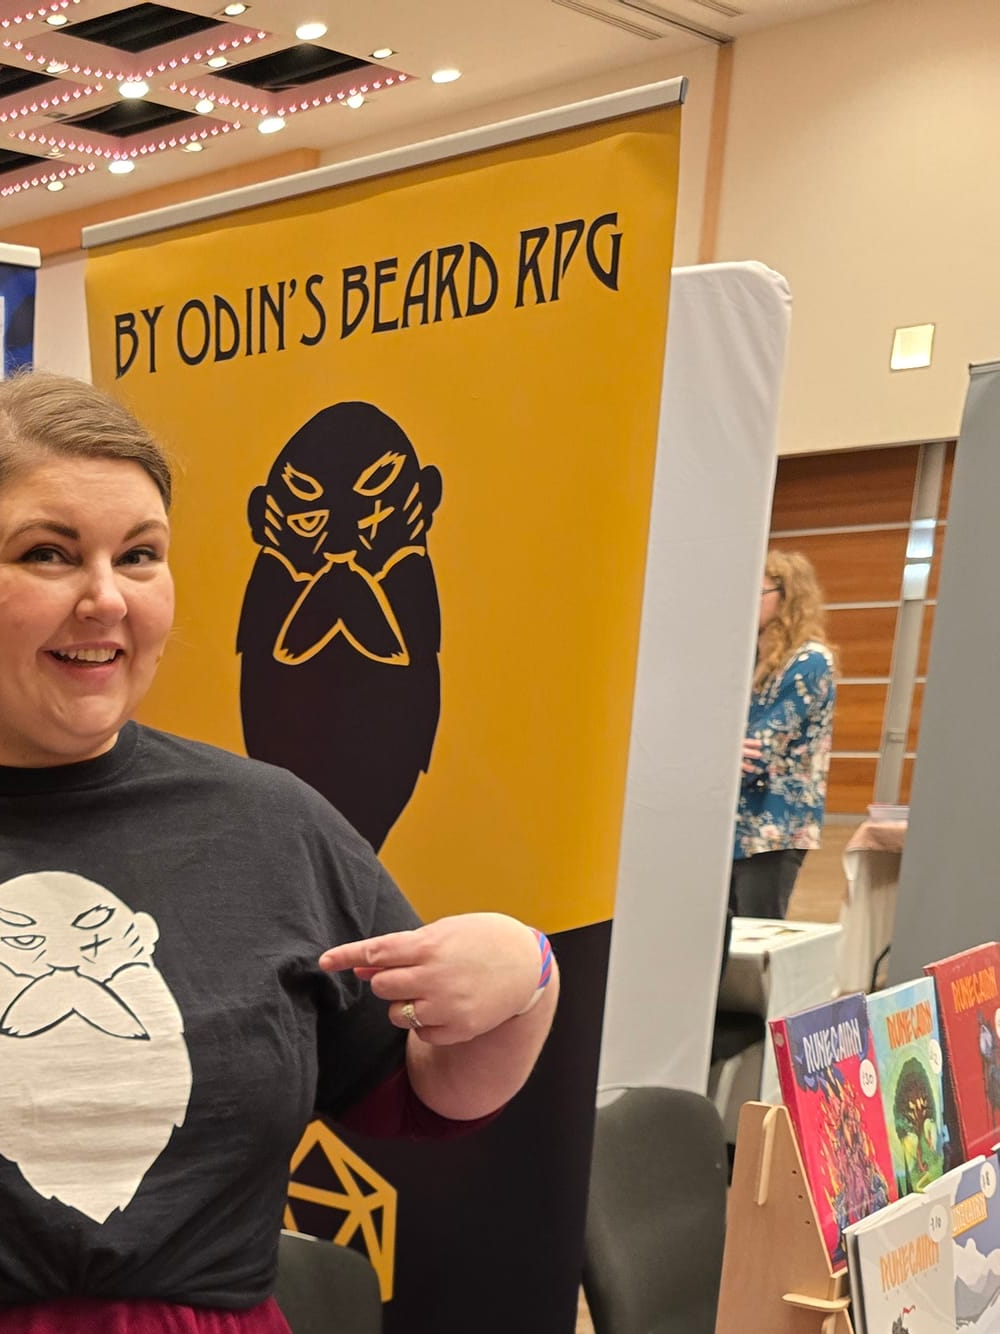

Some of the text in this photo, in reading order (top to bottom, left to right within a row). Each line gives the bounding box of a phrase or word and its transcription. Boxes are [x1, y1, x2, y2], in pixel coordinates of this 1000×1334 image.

[114, 212, 624, 379] BY ODIN'S BEARD RPG
[803, 1019, 862, 1074] RUNECAIRN
